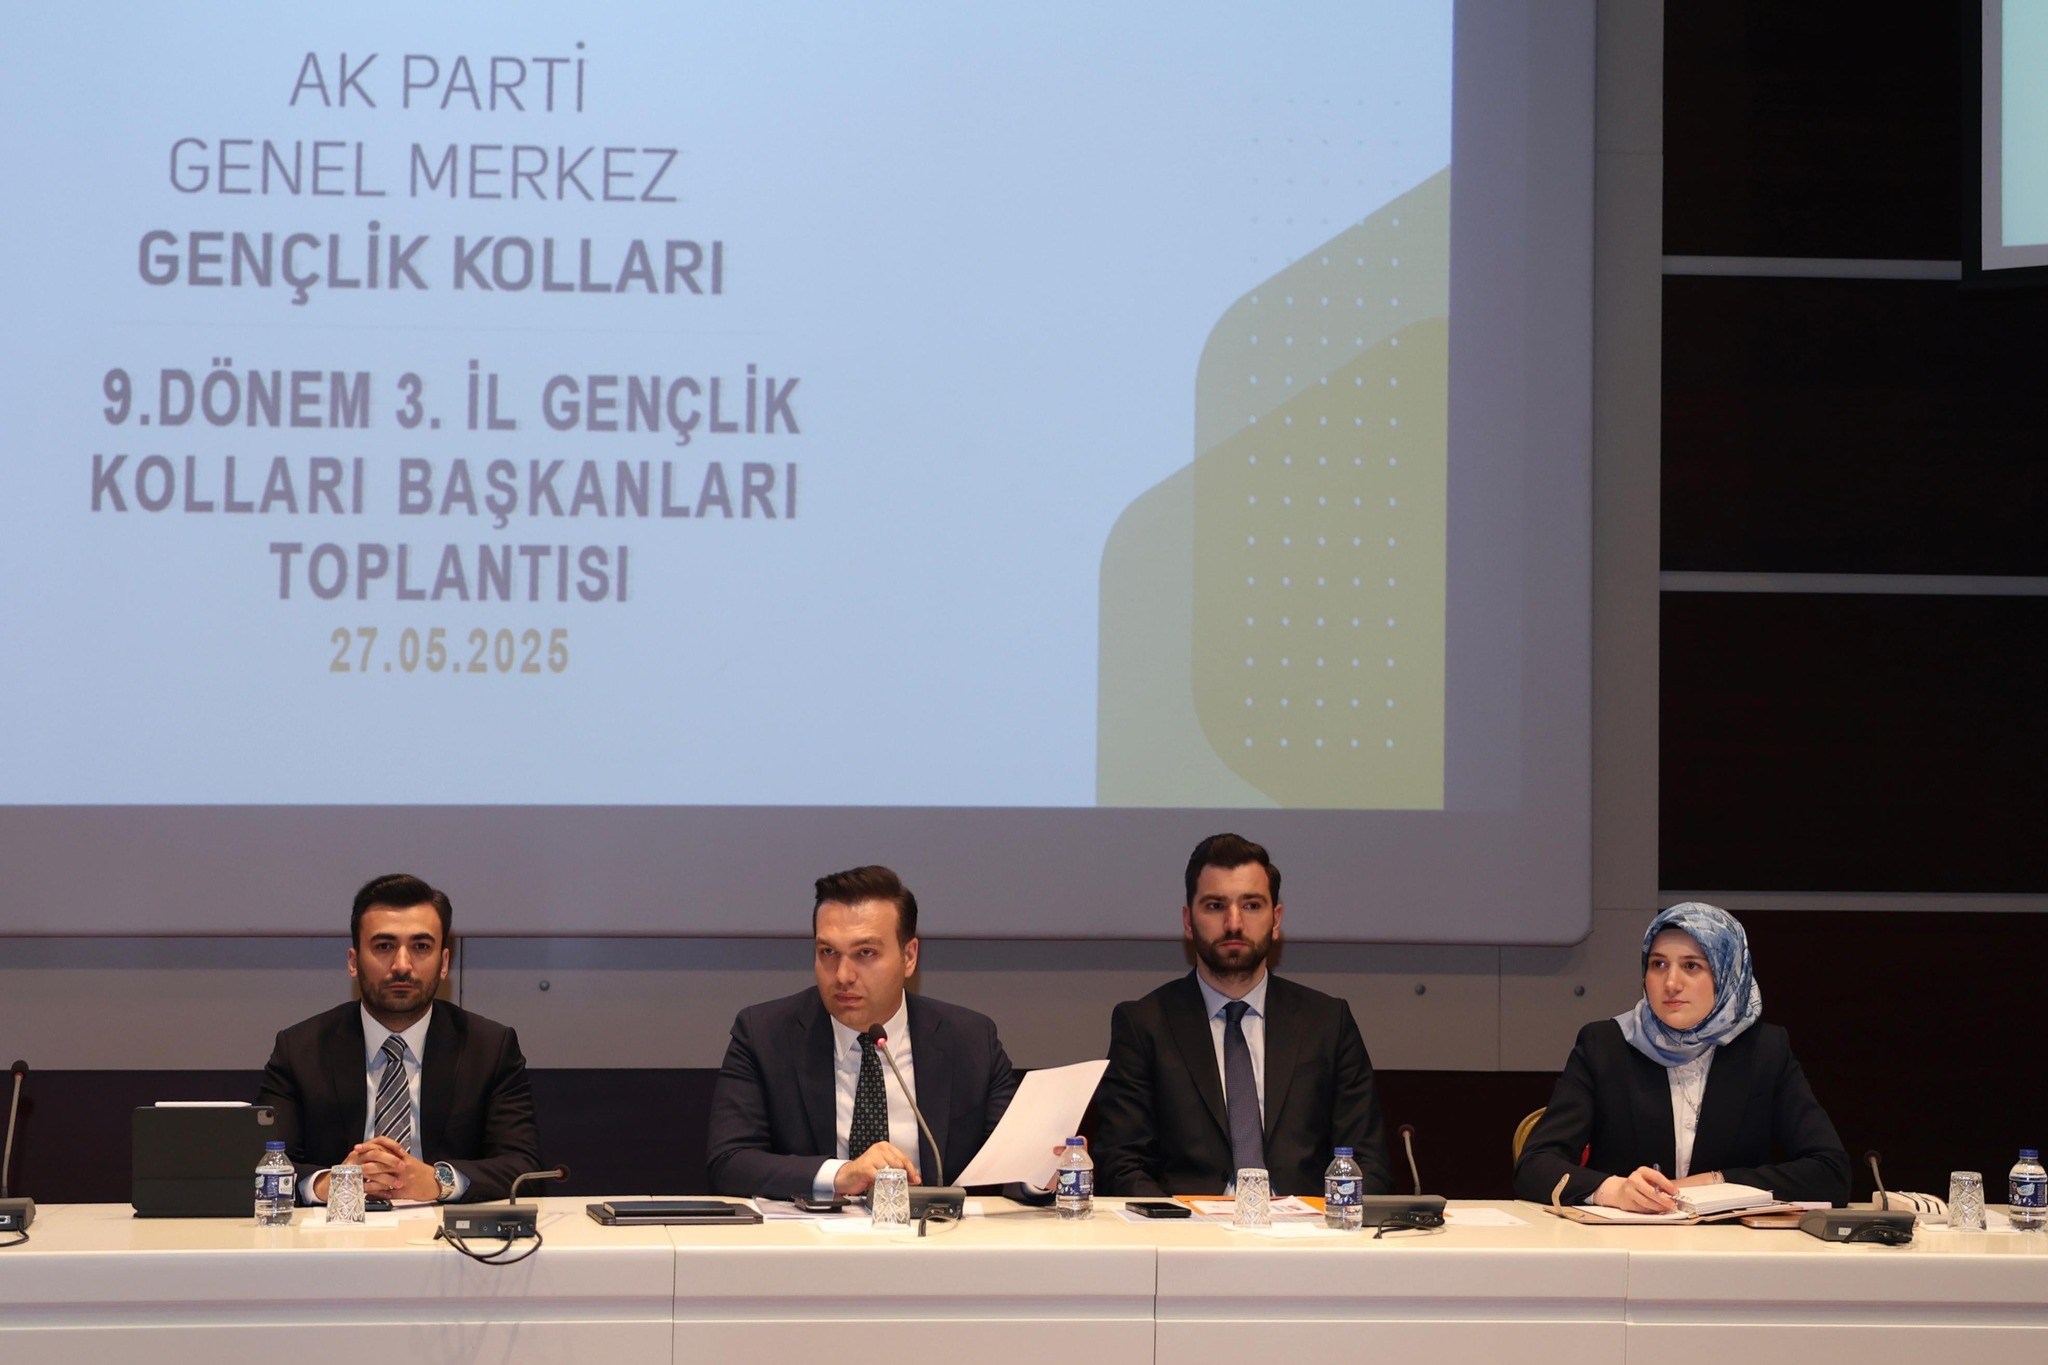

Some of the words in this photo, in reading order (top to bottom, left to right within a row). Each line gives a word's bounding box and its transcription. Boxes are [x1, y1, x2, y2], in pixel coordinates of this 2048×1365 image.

[289, 51, 378, 109] AK
[402, 41, 586, 113] PARTİ
[169, 137, 387, 197] GENEL
[409, 142, 680, 203] MERKEZ
[138, 220, 430, 306] GENÇLİK
[453, 235, 724, 295] KOLLARI
[102, 356, 371, 429] 9.DÖNEM
[395, 371, 442, 430] 3.
[467, 358, 517, 431] İL
[542, 363, 801, 447] GENÇLİK
[90, 454, 364, 515] KOLLARI
[398, 457, 797, 530] BAŞKANLARI
[269, 542, 628, 603] TOPLANTISI
[329, 626, 570, 674] 27.05.2025
